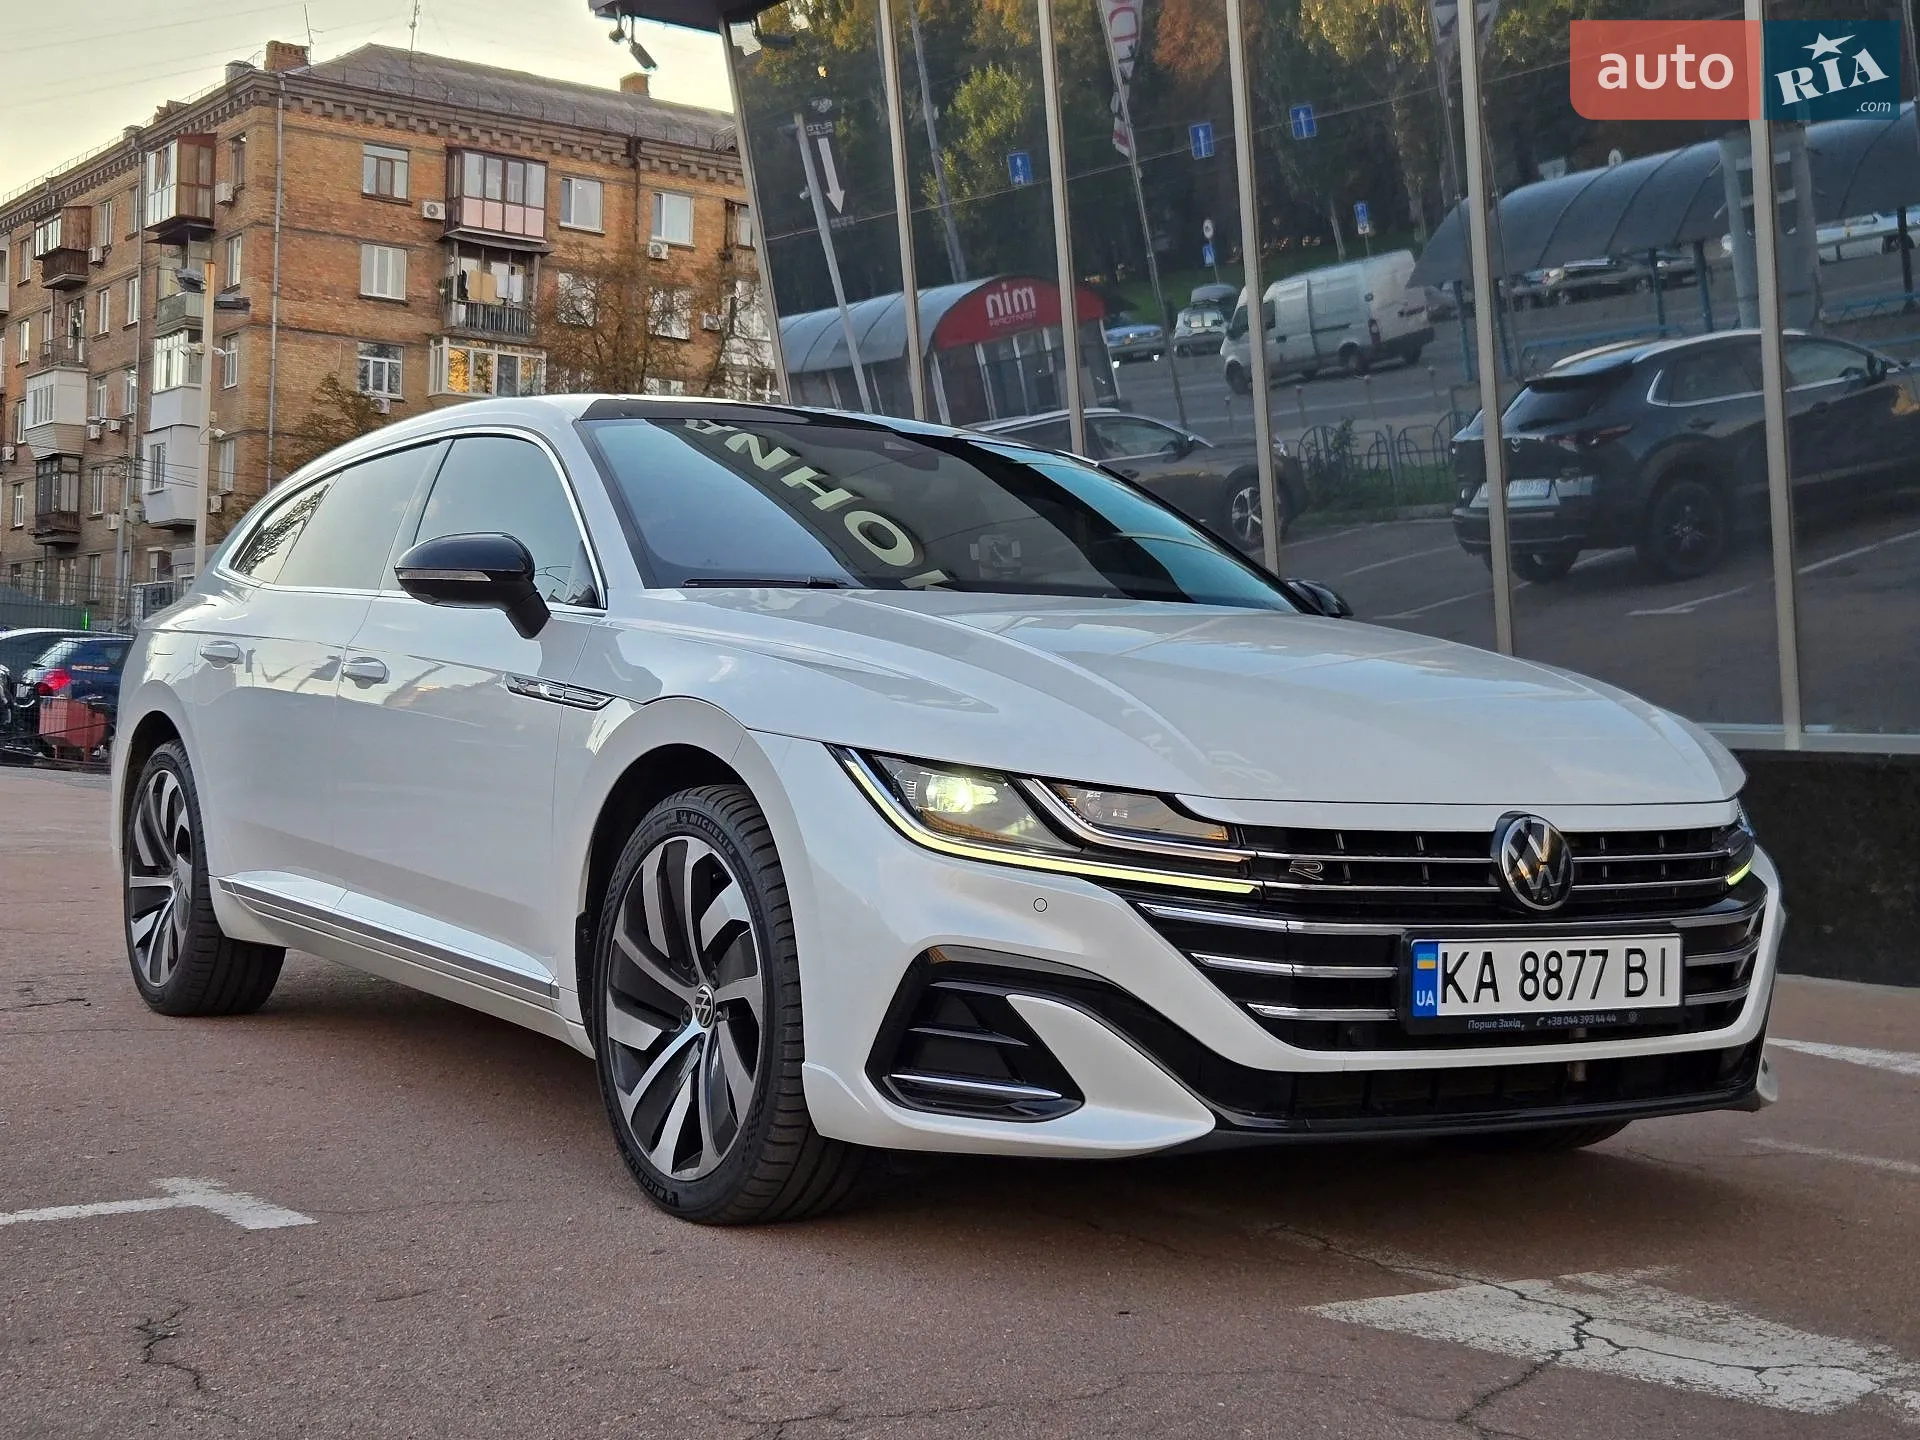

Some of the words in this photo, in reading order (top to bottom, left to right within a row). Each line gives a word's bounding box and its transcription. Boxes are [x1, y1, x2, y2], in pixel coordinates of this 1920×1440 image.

[689, 812, 736, 855] MICHELIN
[1289, 860, 1323, 881] R
[1440, 951, 1500, 1004] KA
[1518, 949, 1609, 1002] 8877
[1624, 947, 1666, 998] BI
[1416, 990, 1435, 1006] UA
[1468, 1019, 1497, 1030] Порше
[1547, 1015, 1562, 1026] +38
[1563, 1015, 1578, 1025] 044
[1580, 1014, 1595, 1024] 393
[1596, 1013, 1606, 1024] 44
[1606, 1012, 1617, 1023] 44
